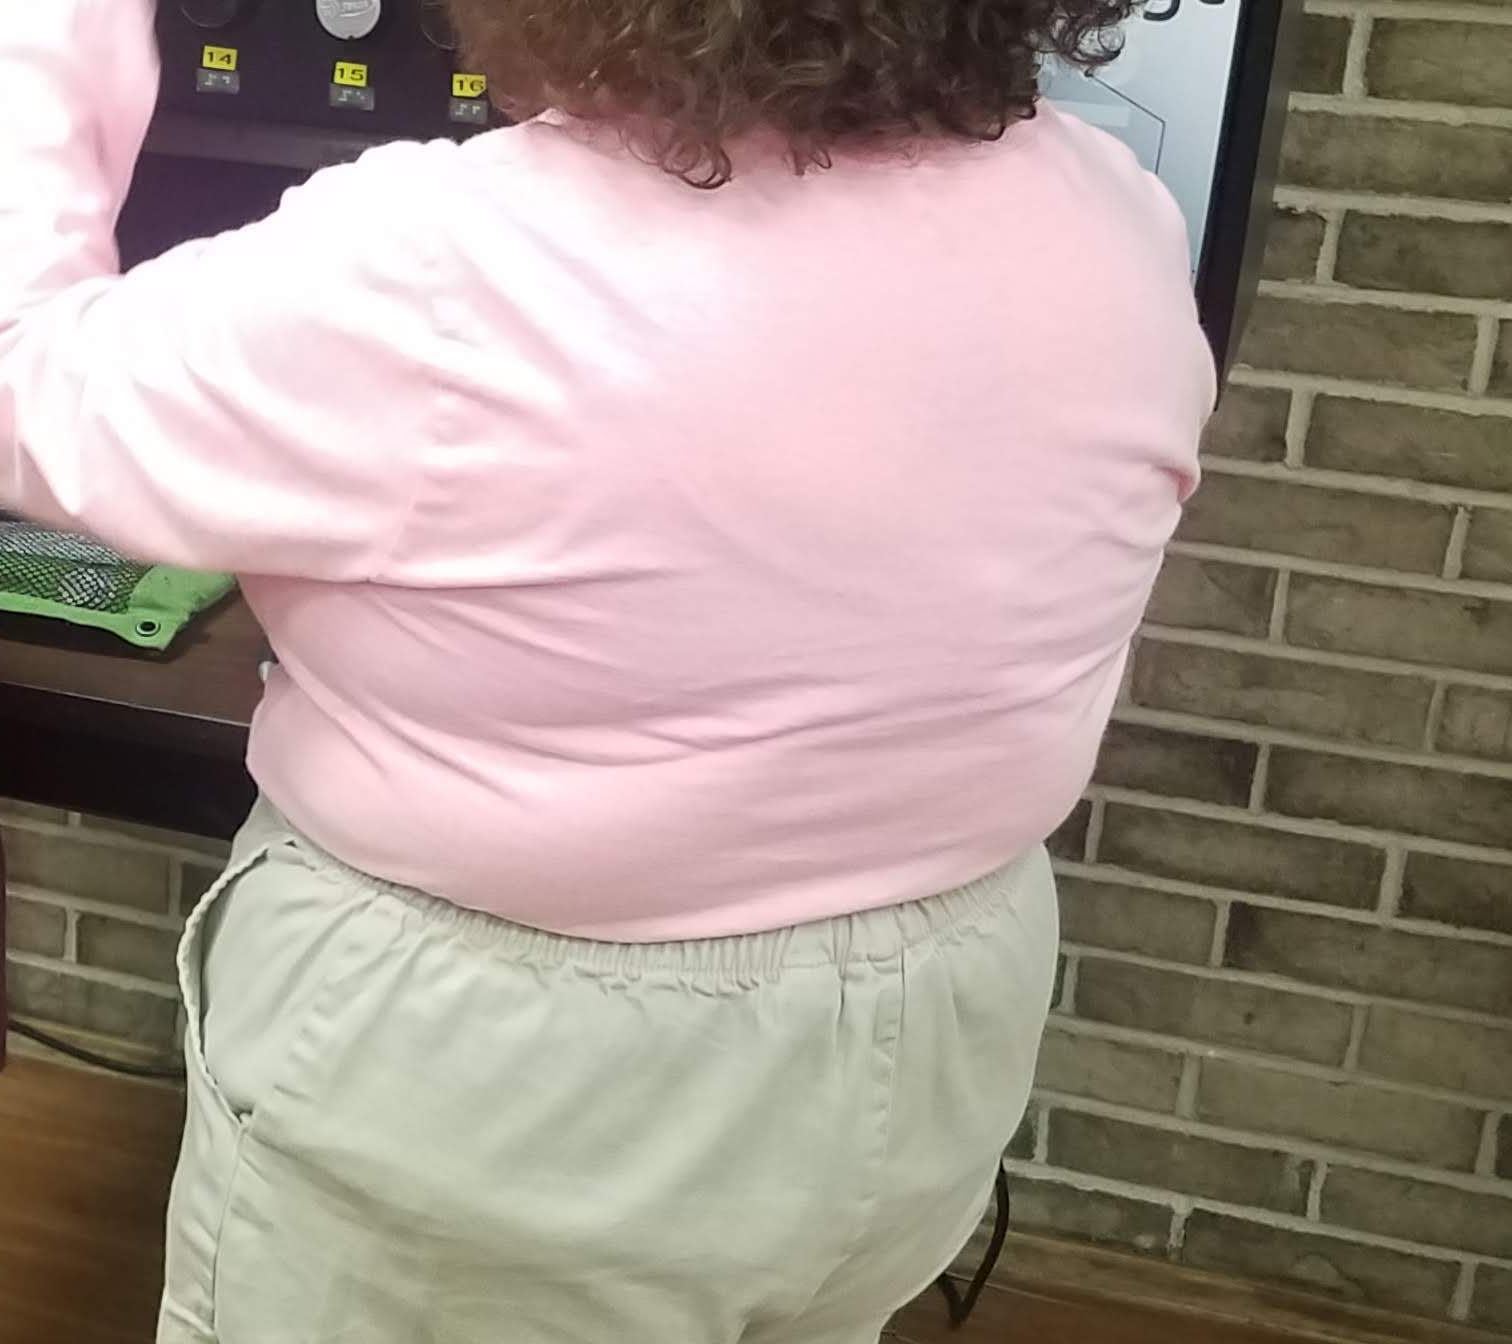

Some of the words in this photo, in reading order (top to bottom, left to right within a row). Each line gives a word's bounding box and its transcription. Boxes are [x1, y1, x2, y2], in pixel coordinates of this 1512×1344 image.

[207, 50, 232, 65] 14
[337, 67, 365, 82] 15
[454, 79, 485, 92] 16
